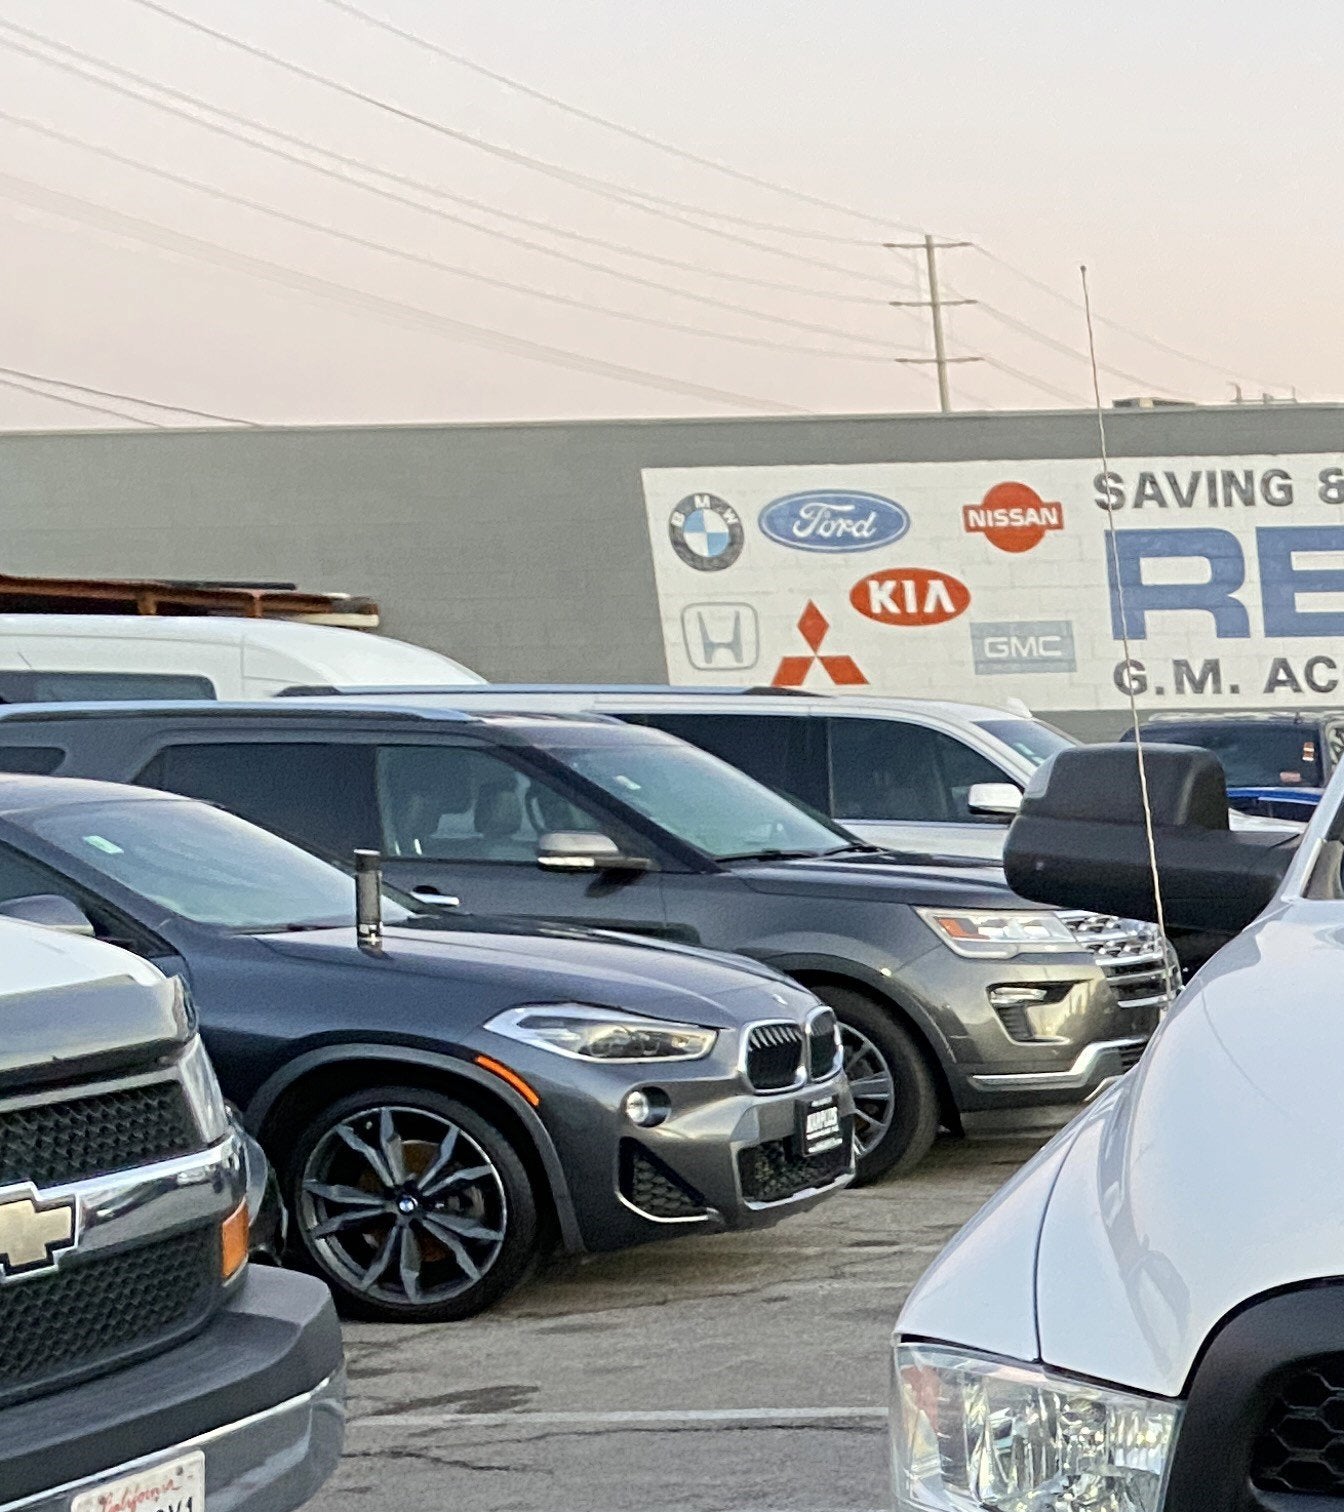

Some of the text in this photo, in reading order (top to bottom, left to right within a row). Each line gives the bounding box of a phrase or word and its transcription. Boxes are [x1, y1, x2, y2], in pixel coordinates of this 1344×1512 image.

[1093, 468, 1294, 511] SAVING
[793, 503, 877, 541] Ford
[968, 505, 1060, 530] NISSAN
[868, 579, 956, 614] KIA
[983, 635, 1063, 660] GMC
[1113, 657, 1240, 697] G.M.
